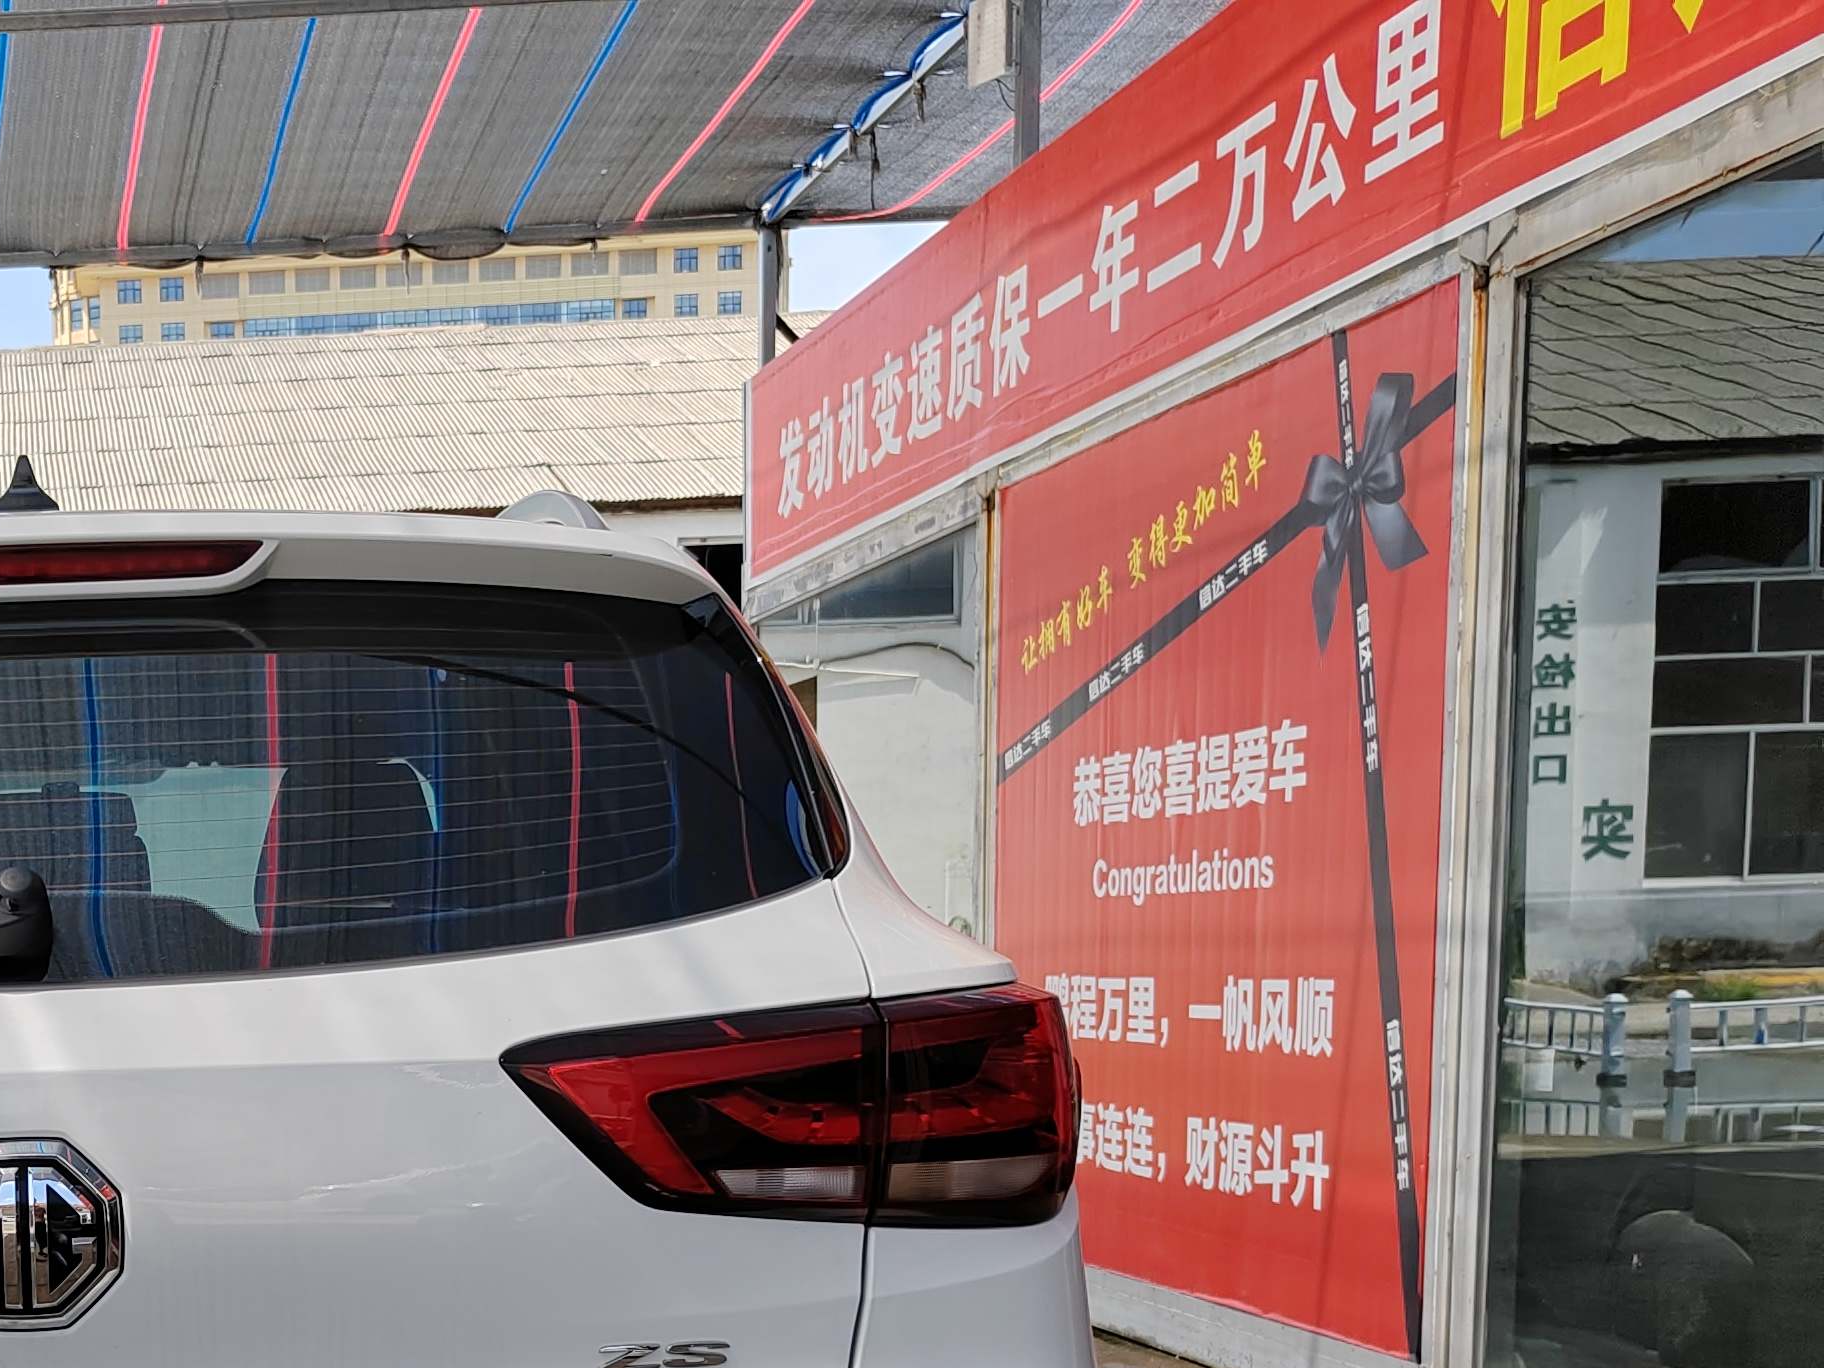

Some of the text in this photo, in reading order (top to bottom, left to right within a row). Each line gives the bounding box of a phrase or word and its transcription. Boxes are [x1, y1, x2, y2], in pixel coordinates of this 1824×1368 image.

[778, 0, 1444, 518] 发动机变速质保一年二万公里
[1022, 430, 1267, 674] 让拥有好车 变得更加简单
[1199, 540, 1269, 611] 信达二手车
[1073, 719, 1308, 827] 恭喜您喜提爱车
[1092, 848, 1275, 907] Congratulations
